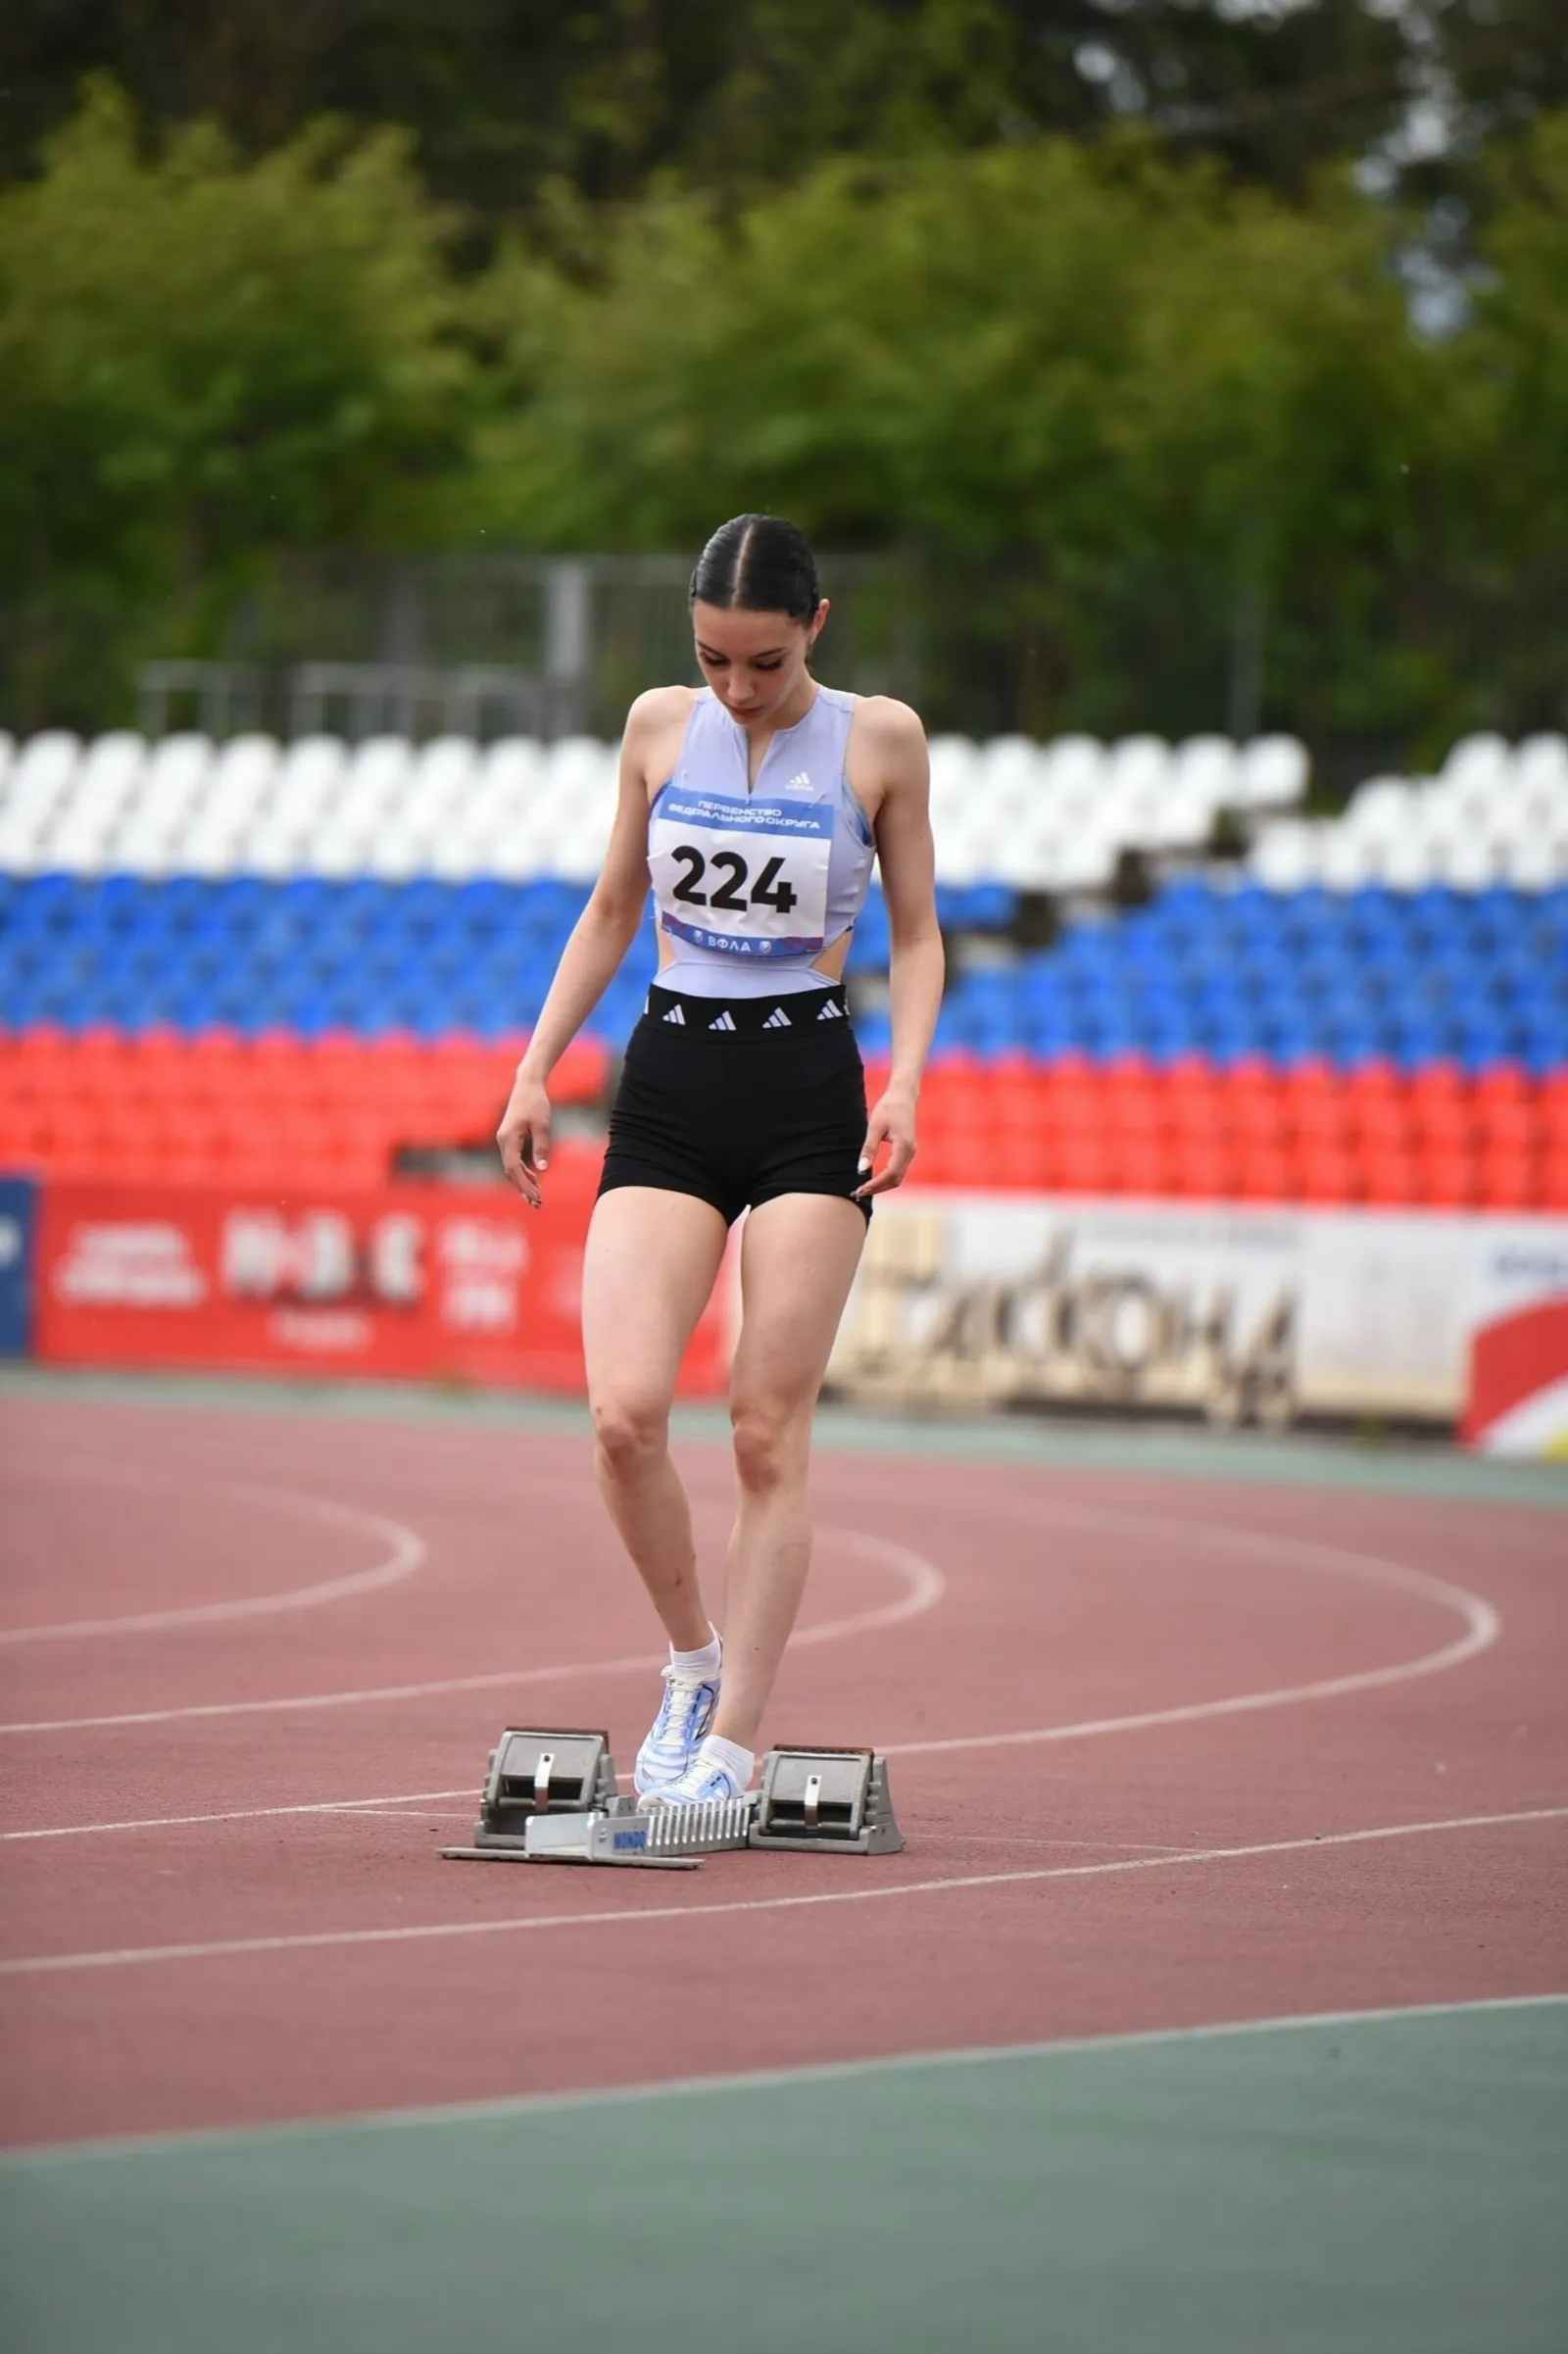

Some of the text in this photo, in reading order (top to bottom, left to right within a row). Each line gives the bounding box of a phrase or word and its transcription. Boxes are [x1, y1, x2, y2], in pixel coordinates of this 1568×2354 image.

[697, 800, 783, 817] ПЕРВЕНСТВО
[766, 816, 821, 830] ОКРУГА
[670, 844, 798, 913] 224
[707, 935, 753, 953] ВФЛА
